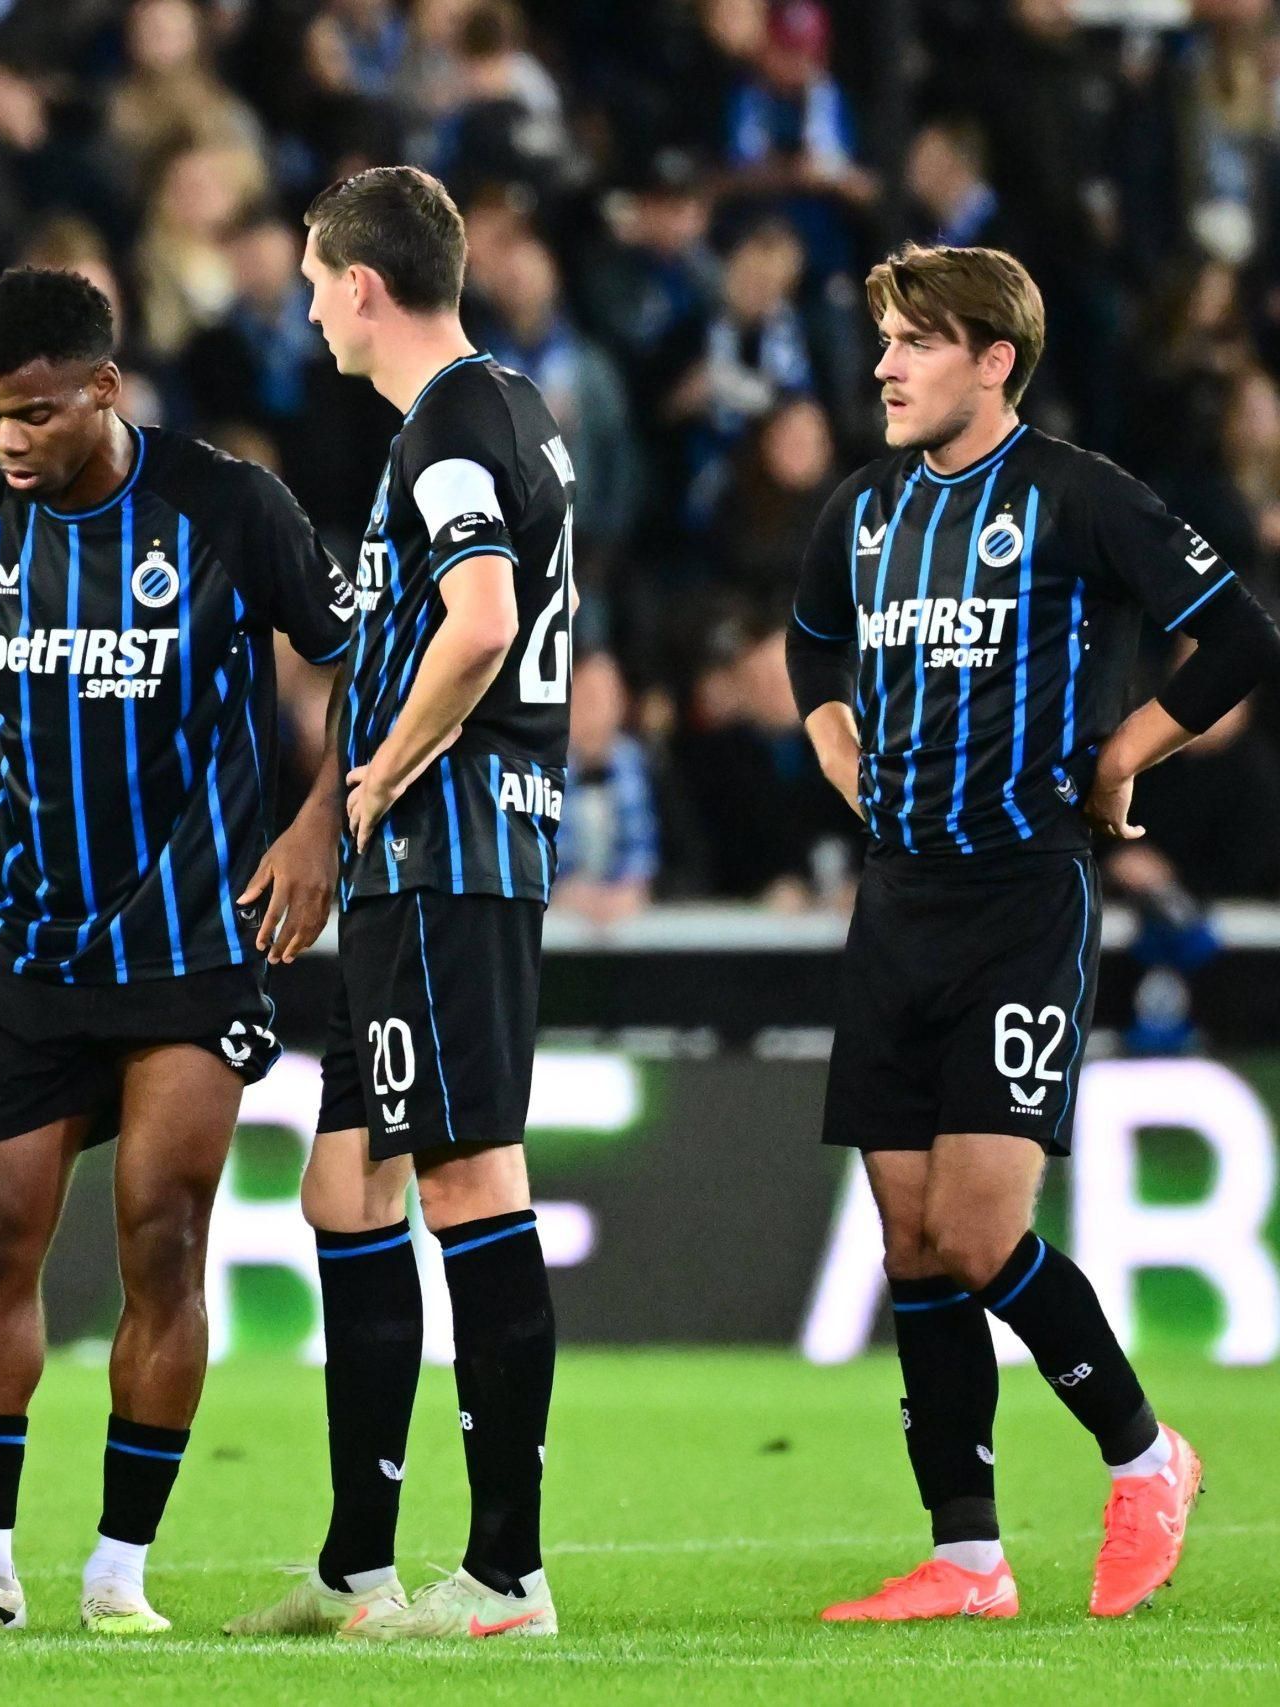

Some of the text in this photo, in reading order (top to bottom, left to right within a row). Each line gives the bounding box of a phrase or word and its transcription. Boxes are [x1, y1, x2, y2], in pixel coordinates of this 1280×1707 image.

[857, 597, 1018, 651] betFIRST
[923, 647, 1000, 668] .SPORT
[78, 678, 161, 699] .SPORT
[499, 772, 563, 822] Allia
[368, 1017, 415, 1095] 20
[994, 1003, 1066, 1081] 62
